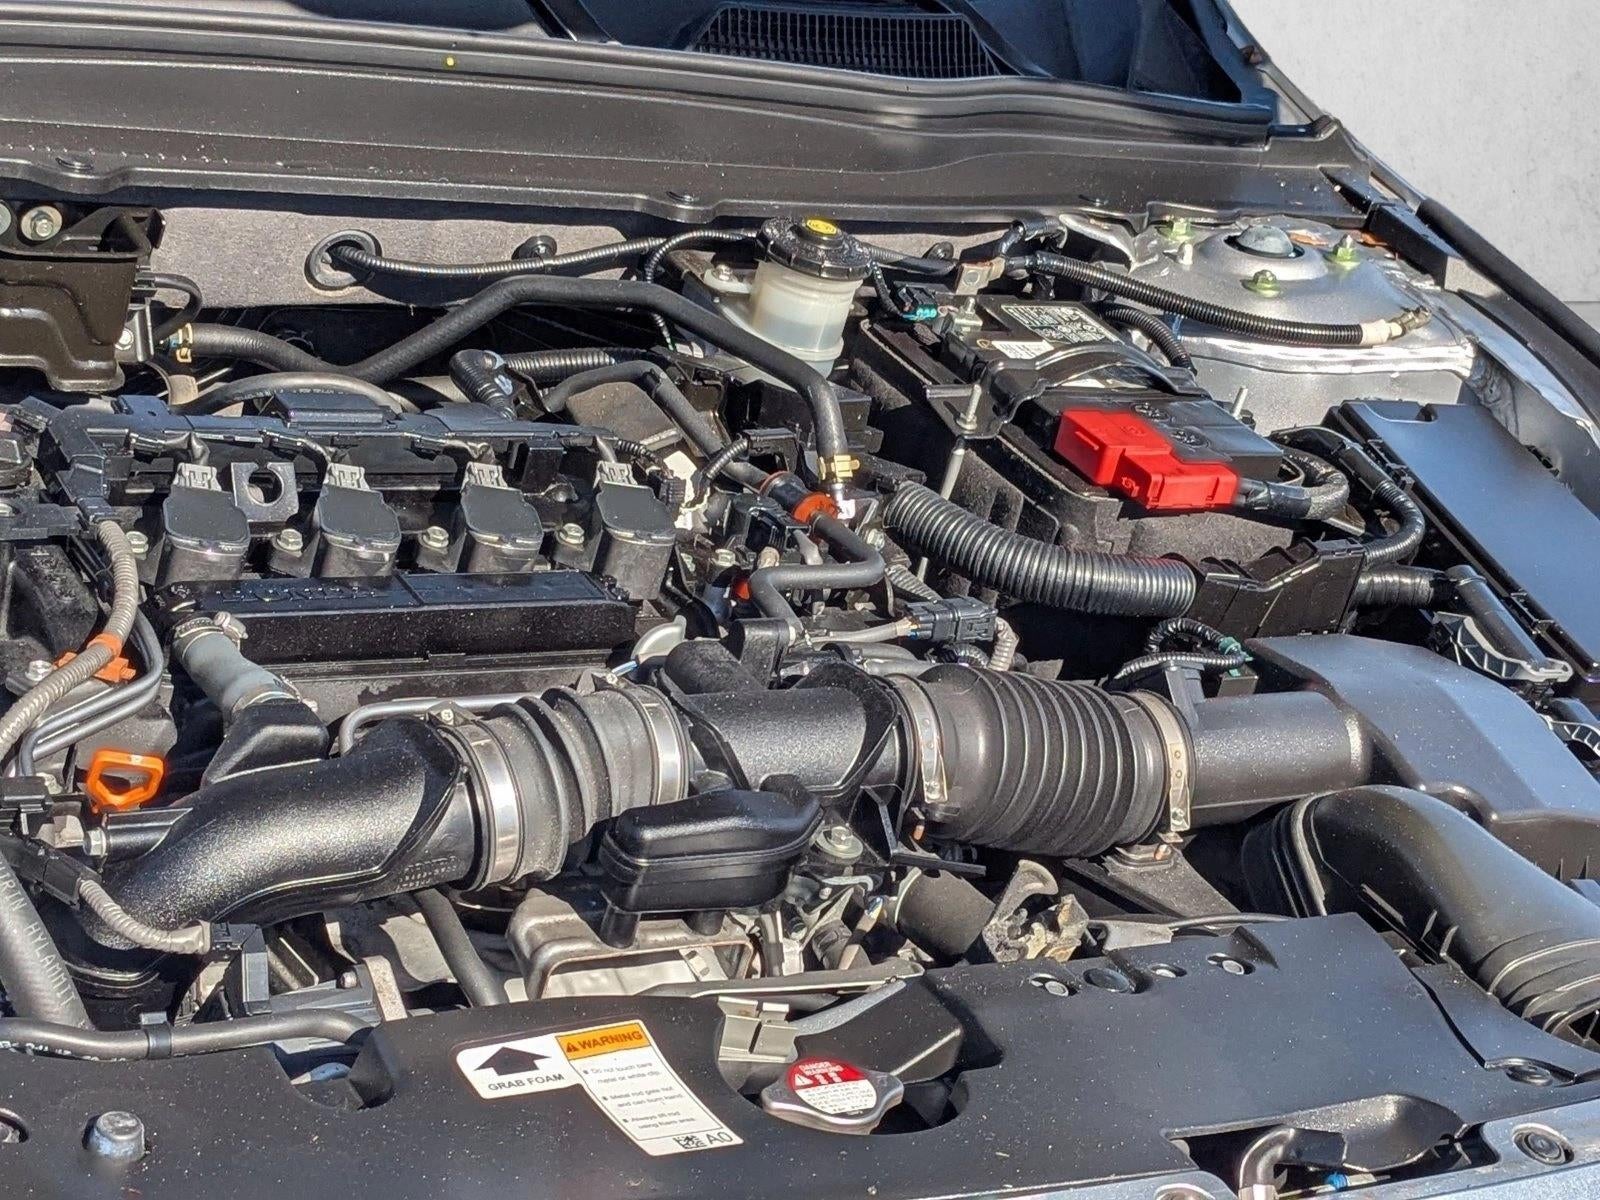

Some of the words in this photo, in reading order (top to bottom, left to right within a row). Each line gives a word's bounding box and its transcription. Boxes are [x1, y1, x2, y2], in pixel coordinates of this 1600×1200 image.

[24, 921, 77, 1007] HYLAMMIT
[577, 1030, 643, 1050] WARNING
[487, 1079, 526, 1092] GRAB
[527, 1073, 565, 1086] FOAM
